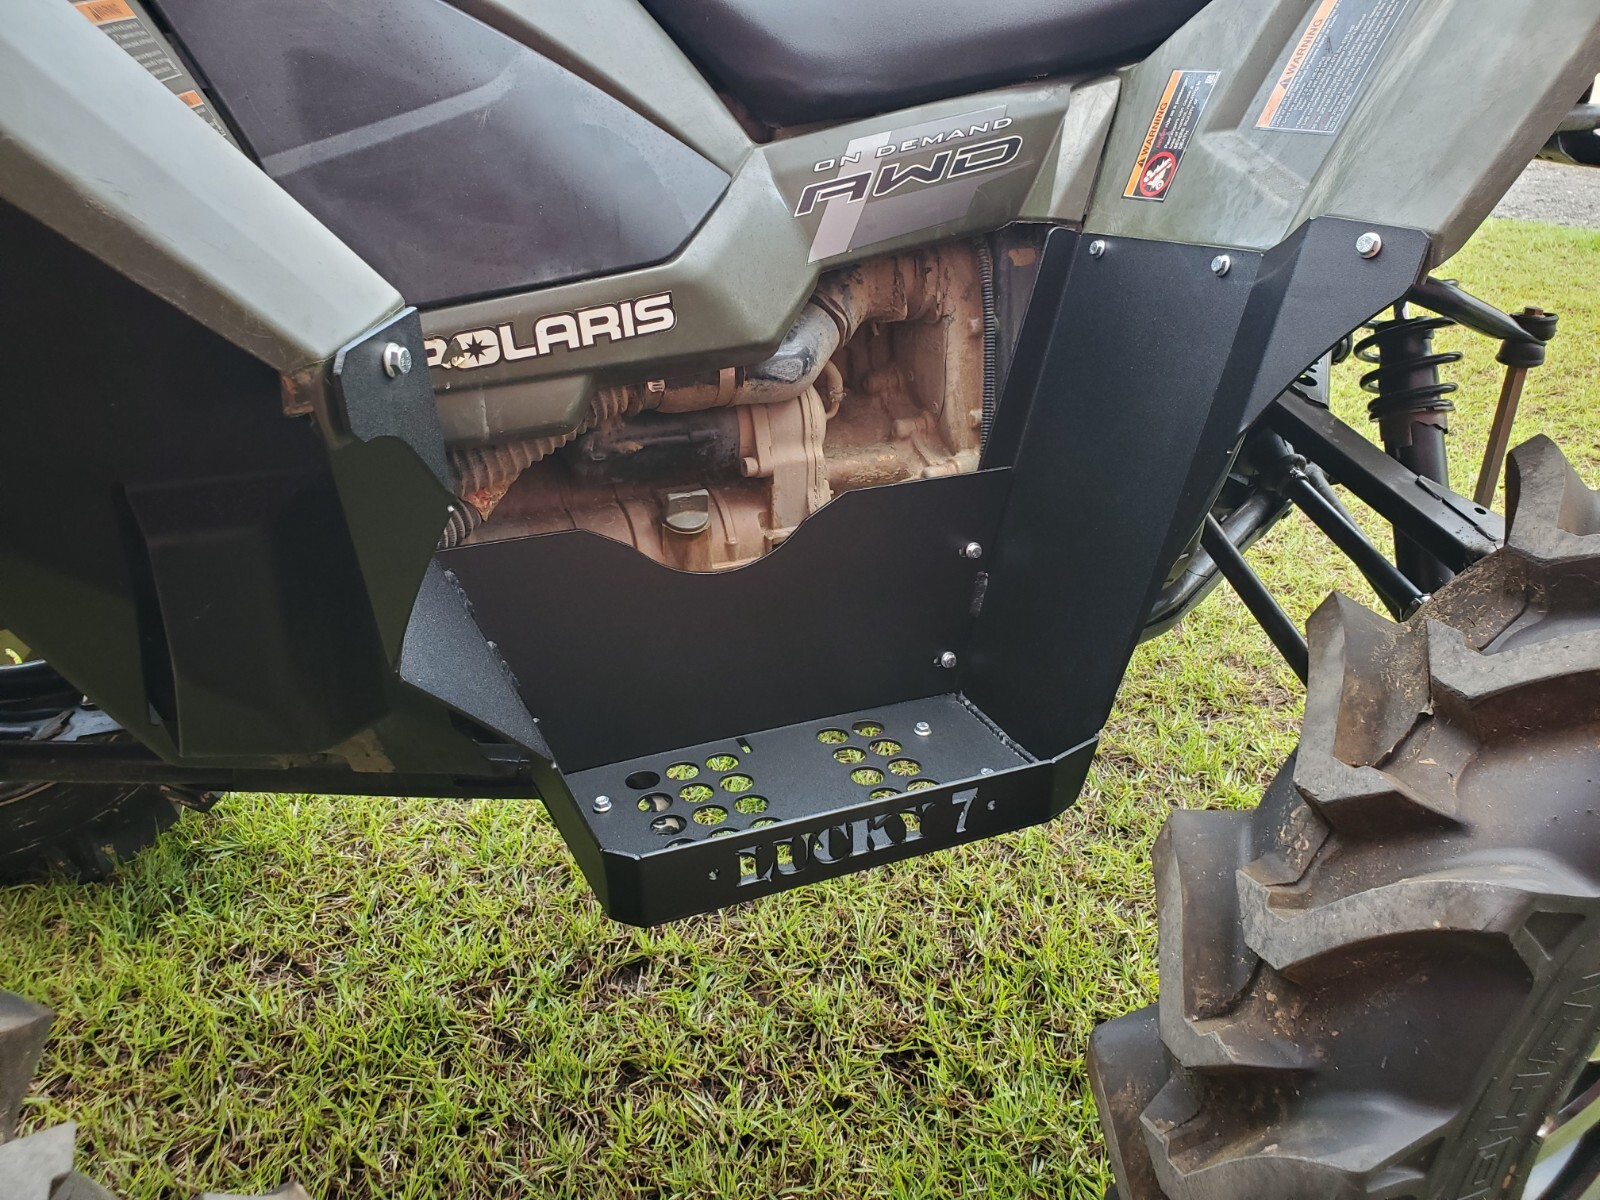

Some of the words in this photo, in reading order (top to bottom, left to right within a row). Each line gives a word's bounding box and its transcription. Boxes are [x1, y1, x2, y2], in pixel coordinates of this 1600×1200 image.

[1286, 18, 1324, 75] WARNING
[813, 152, 862, 173] ON
[875, 116, 1014, 158] DEMAND
[1141, 102, 1168, 157] WARNING
[793, 134, 1023, 218] AWD
[735, 802, 935, 888] LUCKY
[951, 786, 979, 834] 7
